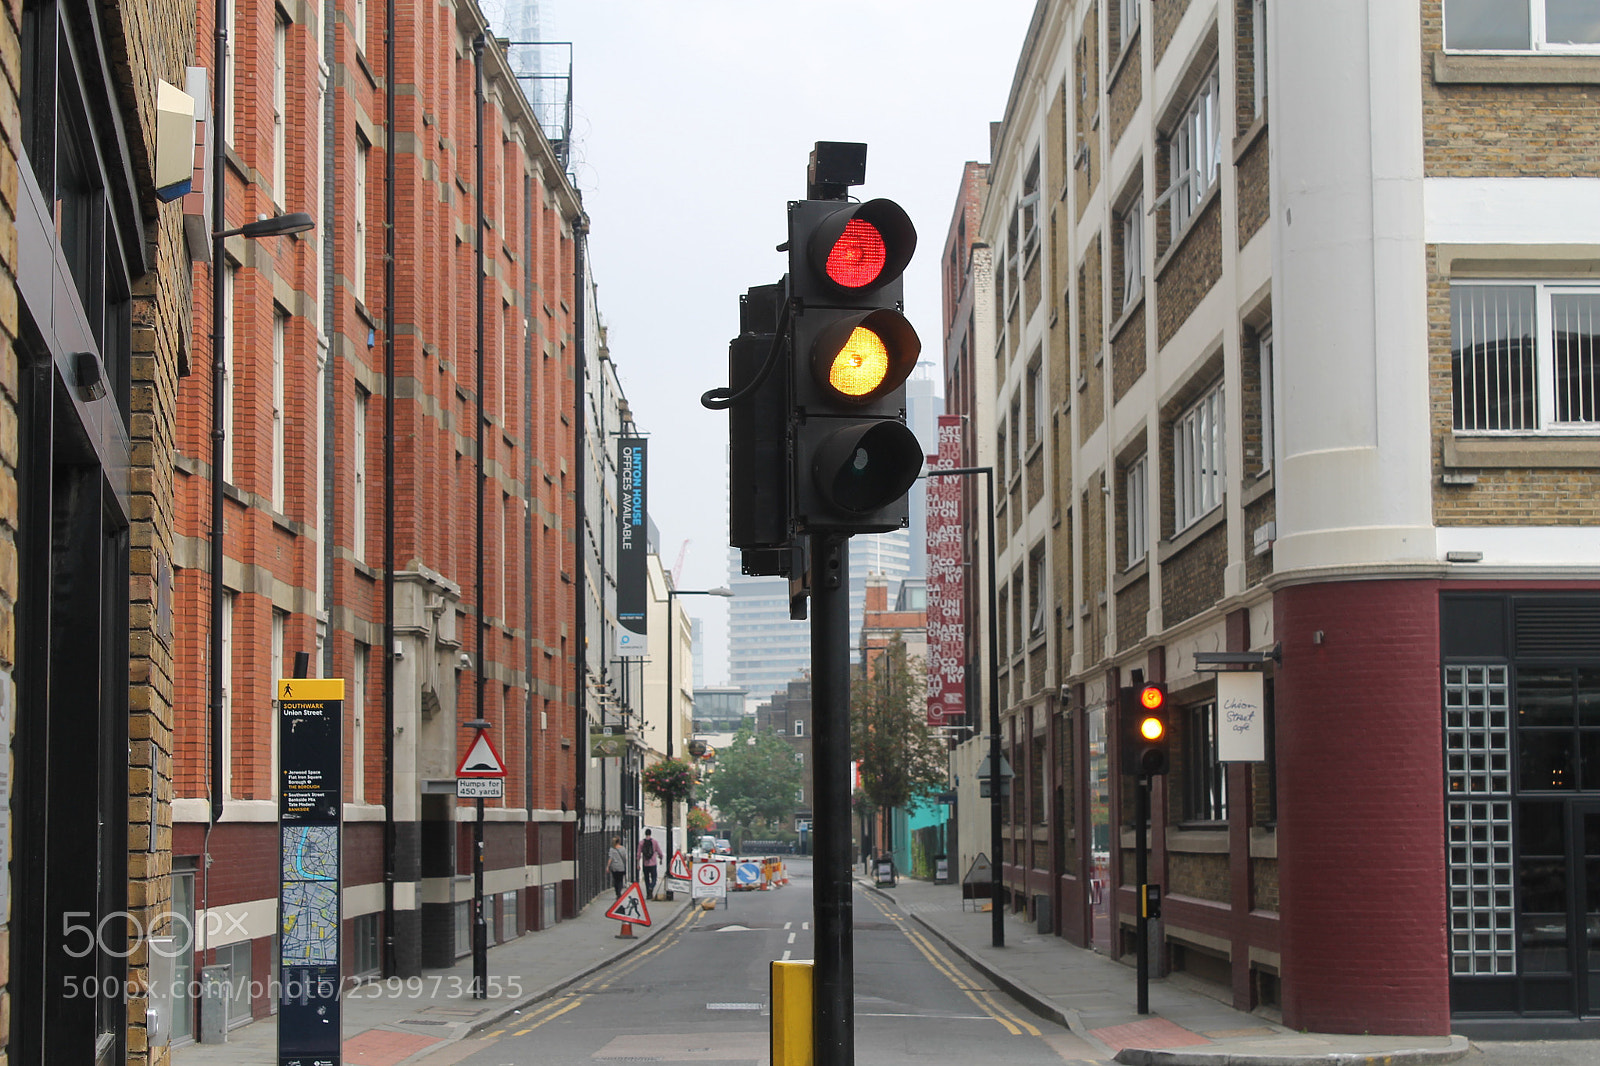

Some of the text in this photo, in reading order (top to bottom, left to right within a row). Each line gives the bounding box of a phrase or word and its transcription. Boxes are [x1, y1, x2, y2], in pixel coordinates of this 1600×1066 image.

[939, 426, 960, 434] ART
[939, 443, 960, 451] STU
[940, 451, 959, 459] DIO
[938, 459, 954, 467] CO
[944, 476, 960, 484] NY
[633, 447, 641, 526] LINTON HOUSE
[623, 447, 632, 549] OFFICES AVAILABLE
[940, 492, 960, 500] 205
[940, 509, 958, 517] ON
[939, 525, 961, 534] ART
[941, 542, 961, 550] STU
[941, 551, 960, 559] DIO
[945, 574, 961, 582] NY
[940, 599, 959, 608] UNI
[943, 608, 960, 616] ON
[940, 624, 964, 633] ART
[943, 649, 963, 658] DIO
[940, 658, 957, 666] CO
[941, 666, 964, 675] MPA
[947, 675, 964, 683] NY
[927, 689, 940, 697] RY
[1224, 698, 1258, 709] Union
[1227, 710, 1255, 722] Street
